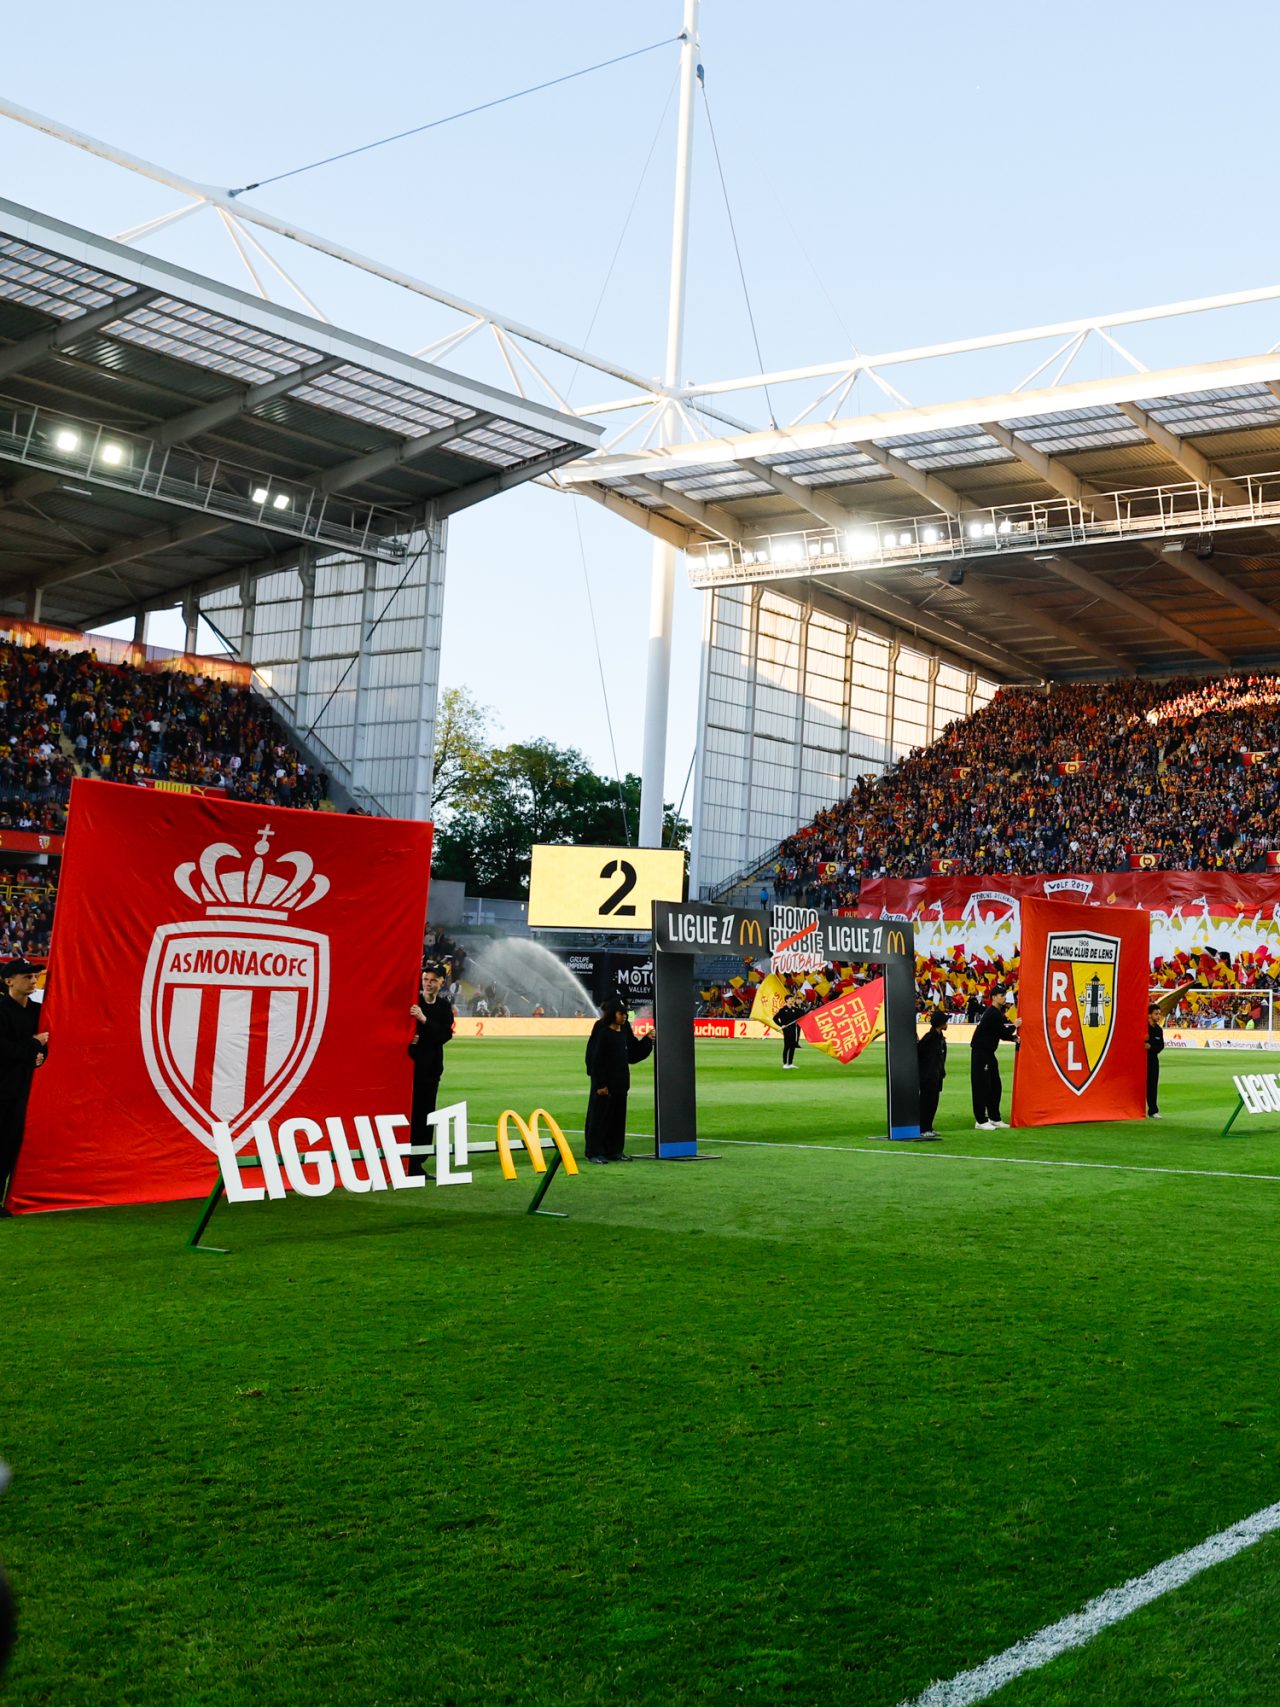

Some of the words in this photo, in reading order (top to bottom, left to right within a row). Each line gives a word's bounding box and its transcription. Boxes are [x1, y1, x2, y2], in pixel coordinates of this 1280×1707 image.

[598, 859, 637, 916] 2
[1071, 880, 1089, 891] 2017
[668, 912, 719, 944] LIGUE
[775, 906, 817, 931] HOMO
[770, 929, 822, 954] PHOBIE
[828, 925, 870, 953] LIGUE
[772, 952, 826, 972] FOOTBALL
[1052, 945, 1074, 957] RACING
[1074, 947, 1090, 958] CLUB
[1090, 948, 1097, 958] DE
[1098, 949, 1113, 959] LENS
[475, 1022, 484, 1037] 2
[694, 1023, 729, 1037] uchan
[739, 1022, 747, 1037] 2
[763, 1024, 772, 1037] 2
[846, 996, 871, 1044] FIERS
[210, 1113, 426, 1204] LIGUE
